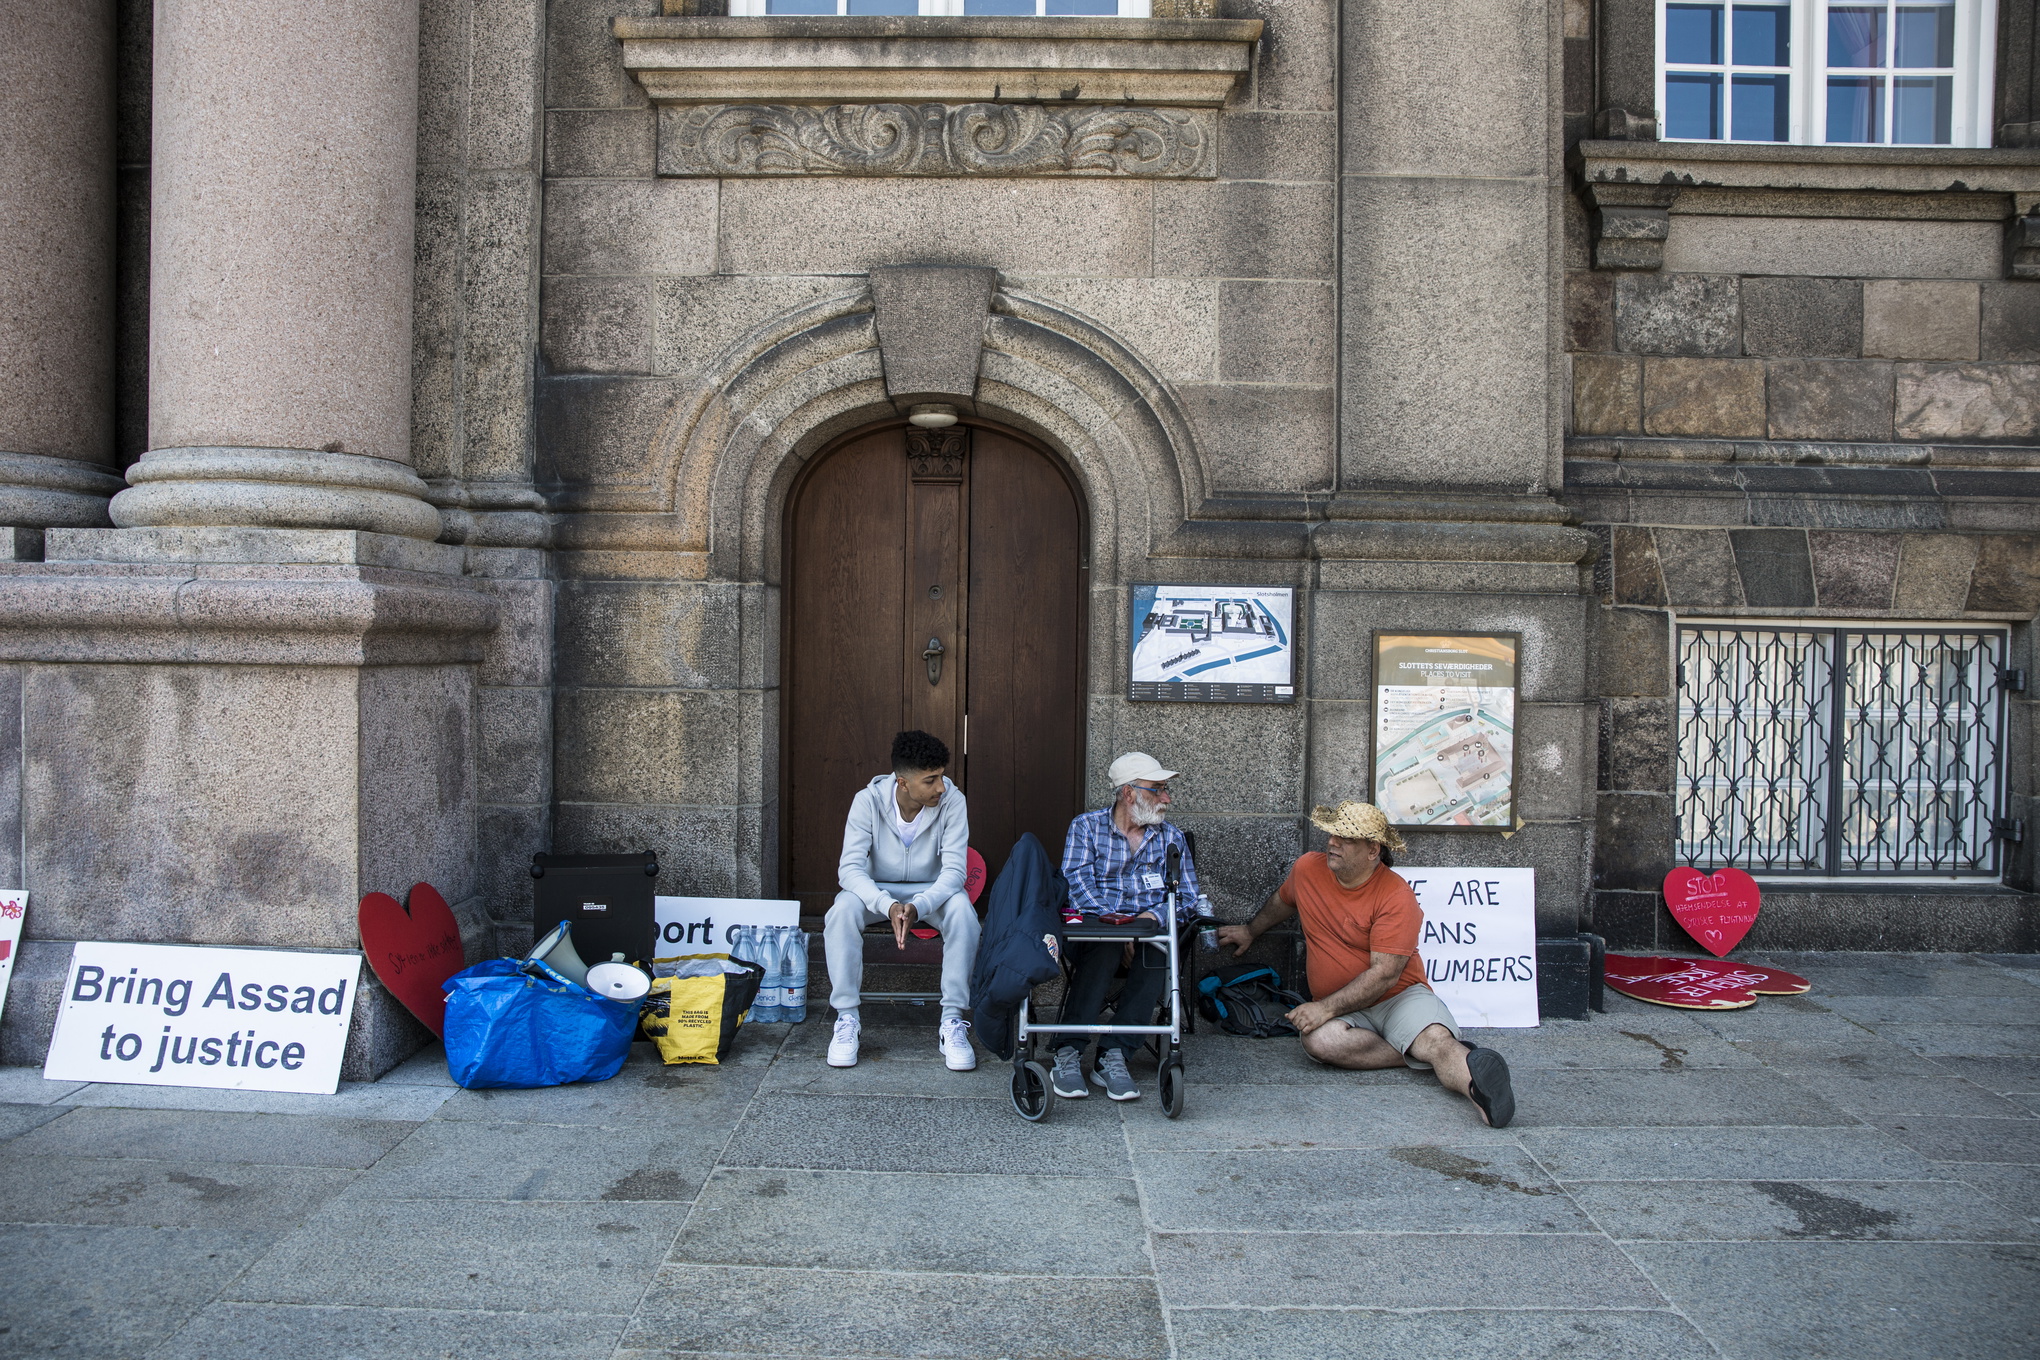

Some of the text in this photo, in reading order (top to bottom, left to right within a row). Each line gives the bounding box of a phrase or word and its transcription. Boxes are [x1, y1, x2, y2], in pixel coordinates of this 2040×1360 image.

[1448, 880, 1500, 906] ARE
[1686, 874, 1726, 896] STOP
[1424, 920, 1476, 944] ANS
[71, 965, 347, 1017] Bring Assad
[100, 1024, 306, 1073] to justice
